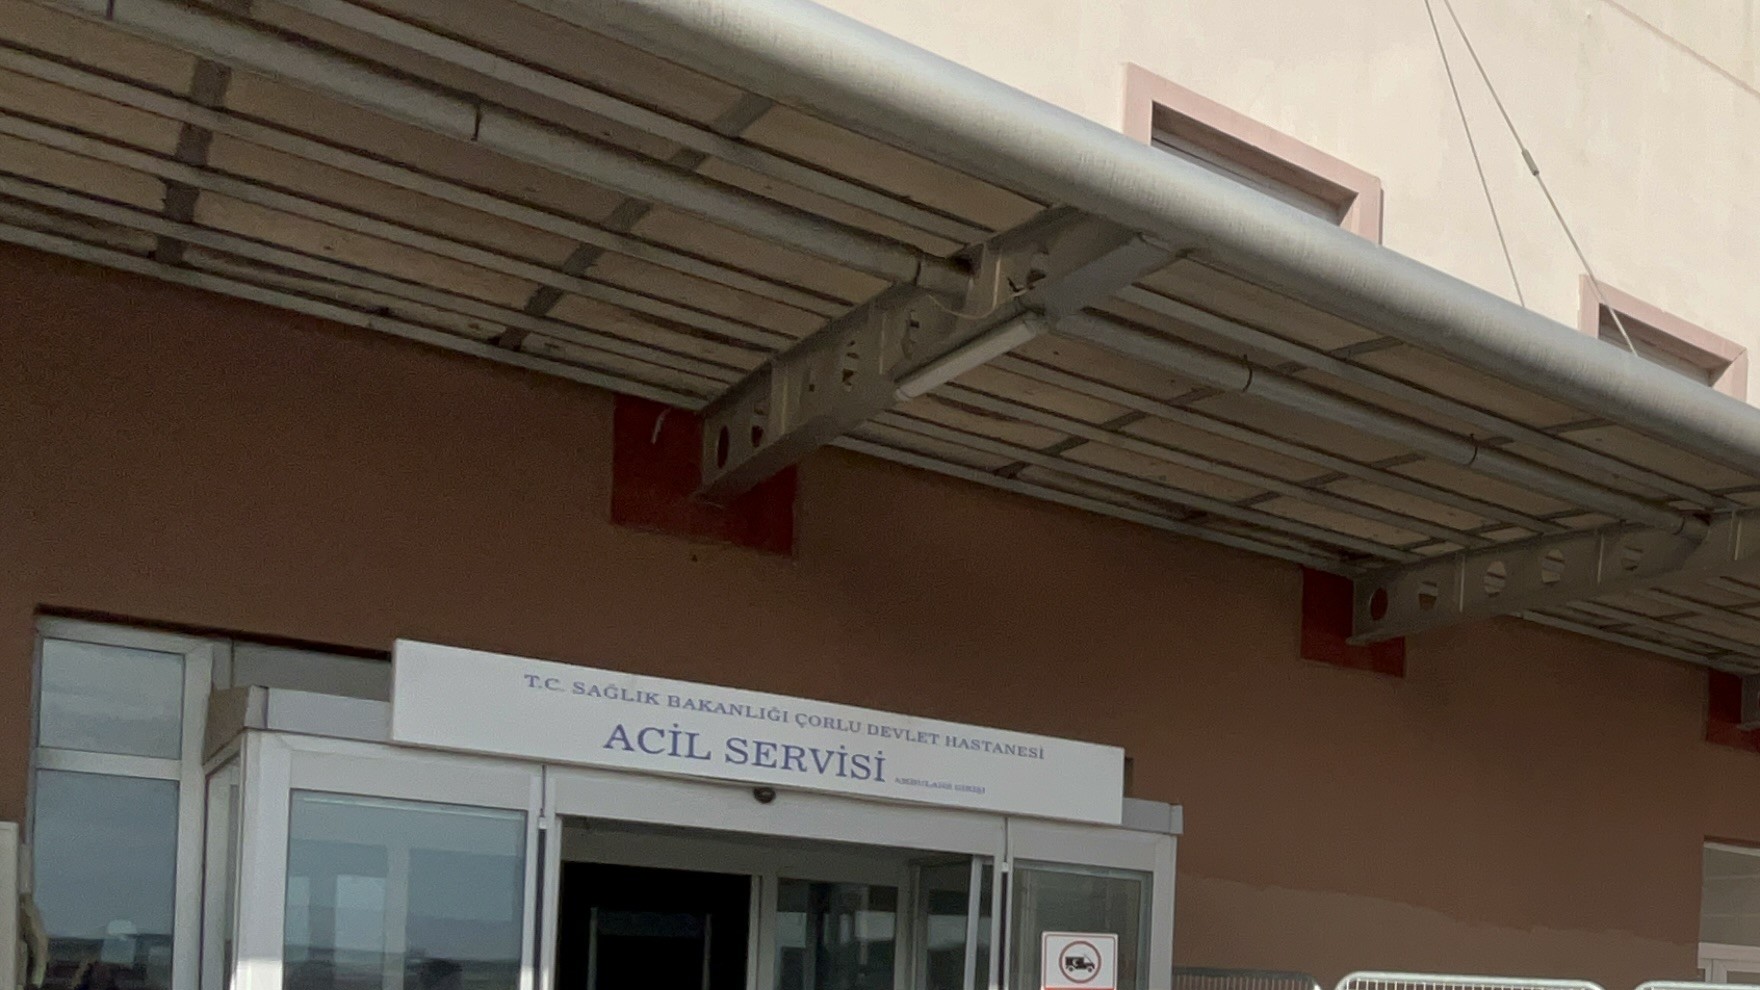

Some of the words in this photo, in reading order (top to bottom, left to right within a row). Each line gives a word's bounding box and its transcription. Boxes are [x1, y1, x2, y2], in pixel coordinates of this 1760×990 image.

[524, 674, 565, 692] T.C.
[572, 682, 660, 706] SAĞLIK
[667, 695, 790, 723] BAKANLIĞI
[794, 711, 863, 733] ÇORLU
[867, 724, 940, 745] DEVLET
[945, 735, 1046, 760] HASTANESİ
[602, 722, 712, 761] ACİL
[725, 737, 887, 782] SERVİSİ
